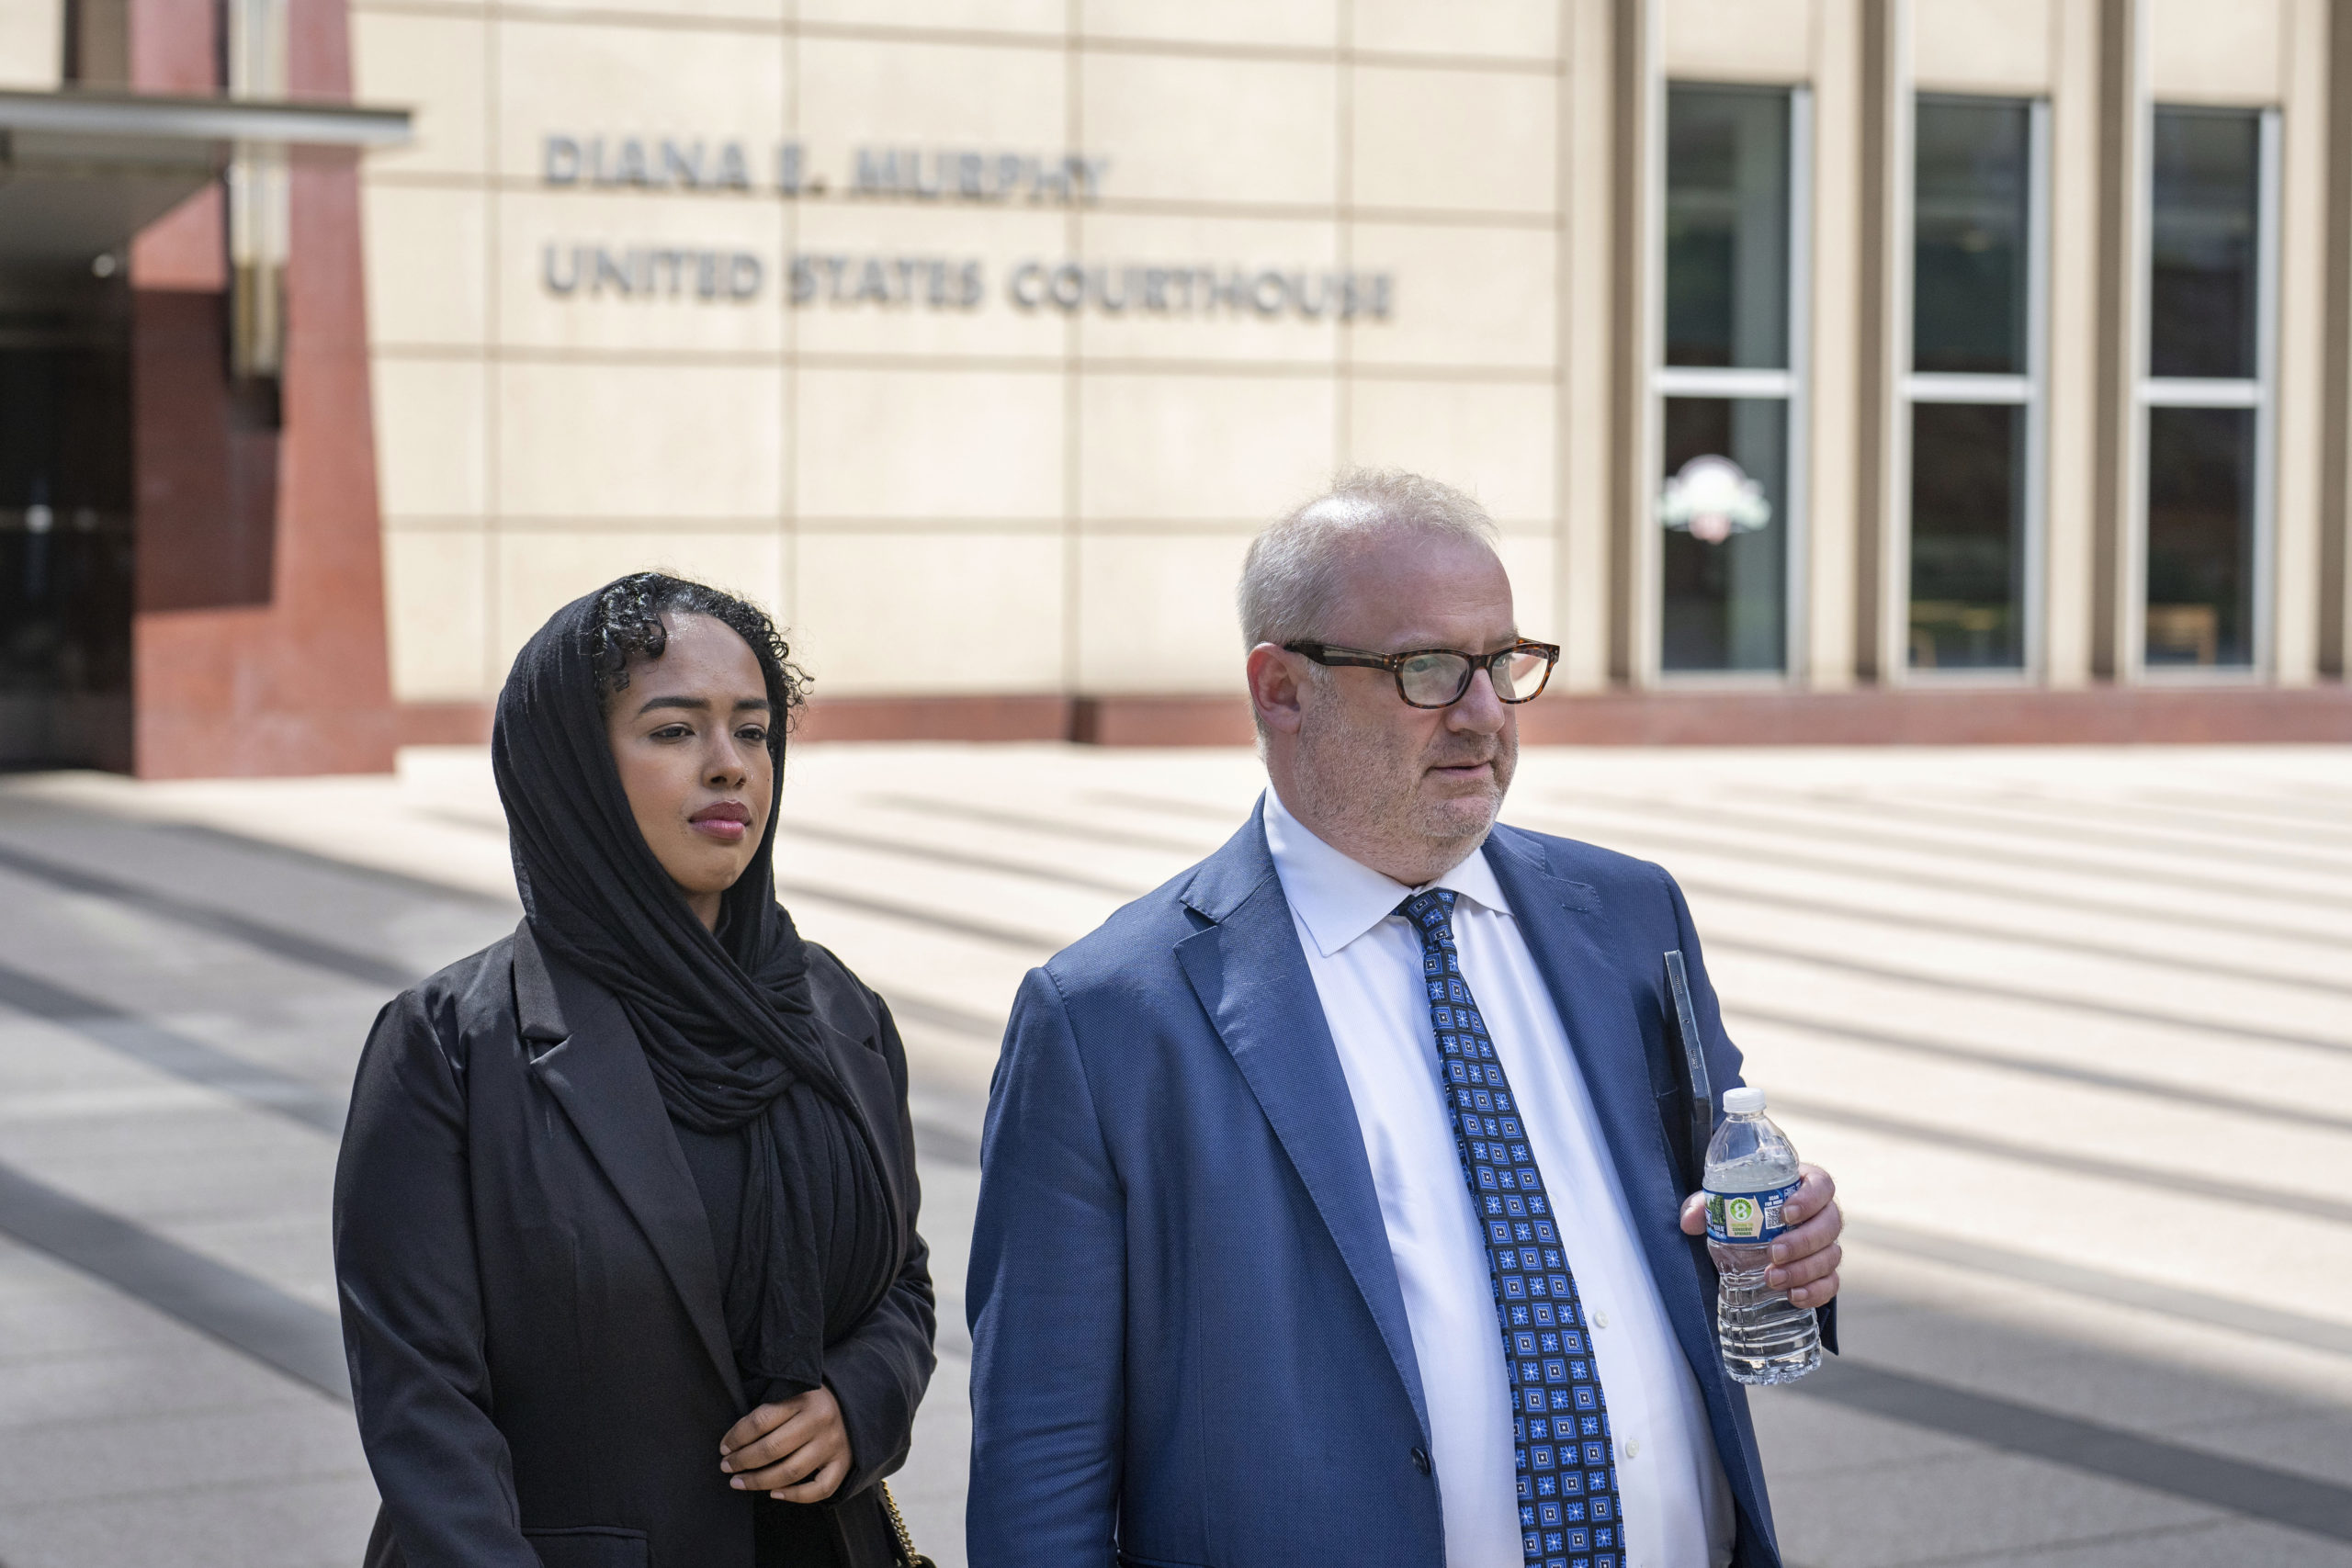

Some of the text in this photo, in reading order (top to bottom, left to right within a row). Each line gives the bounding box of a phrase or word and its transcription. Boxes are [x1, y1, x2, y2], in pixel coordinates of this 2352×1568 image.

[543, 136, 1110, 203] DIANA E. MURPHY
[542, 243, 1394, 322] UNITED STATES COURTHOUSE
